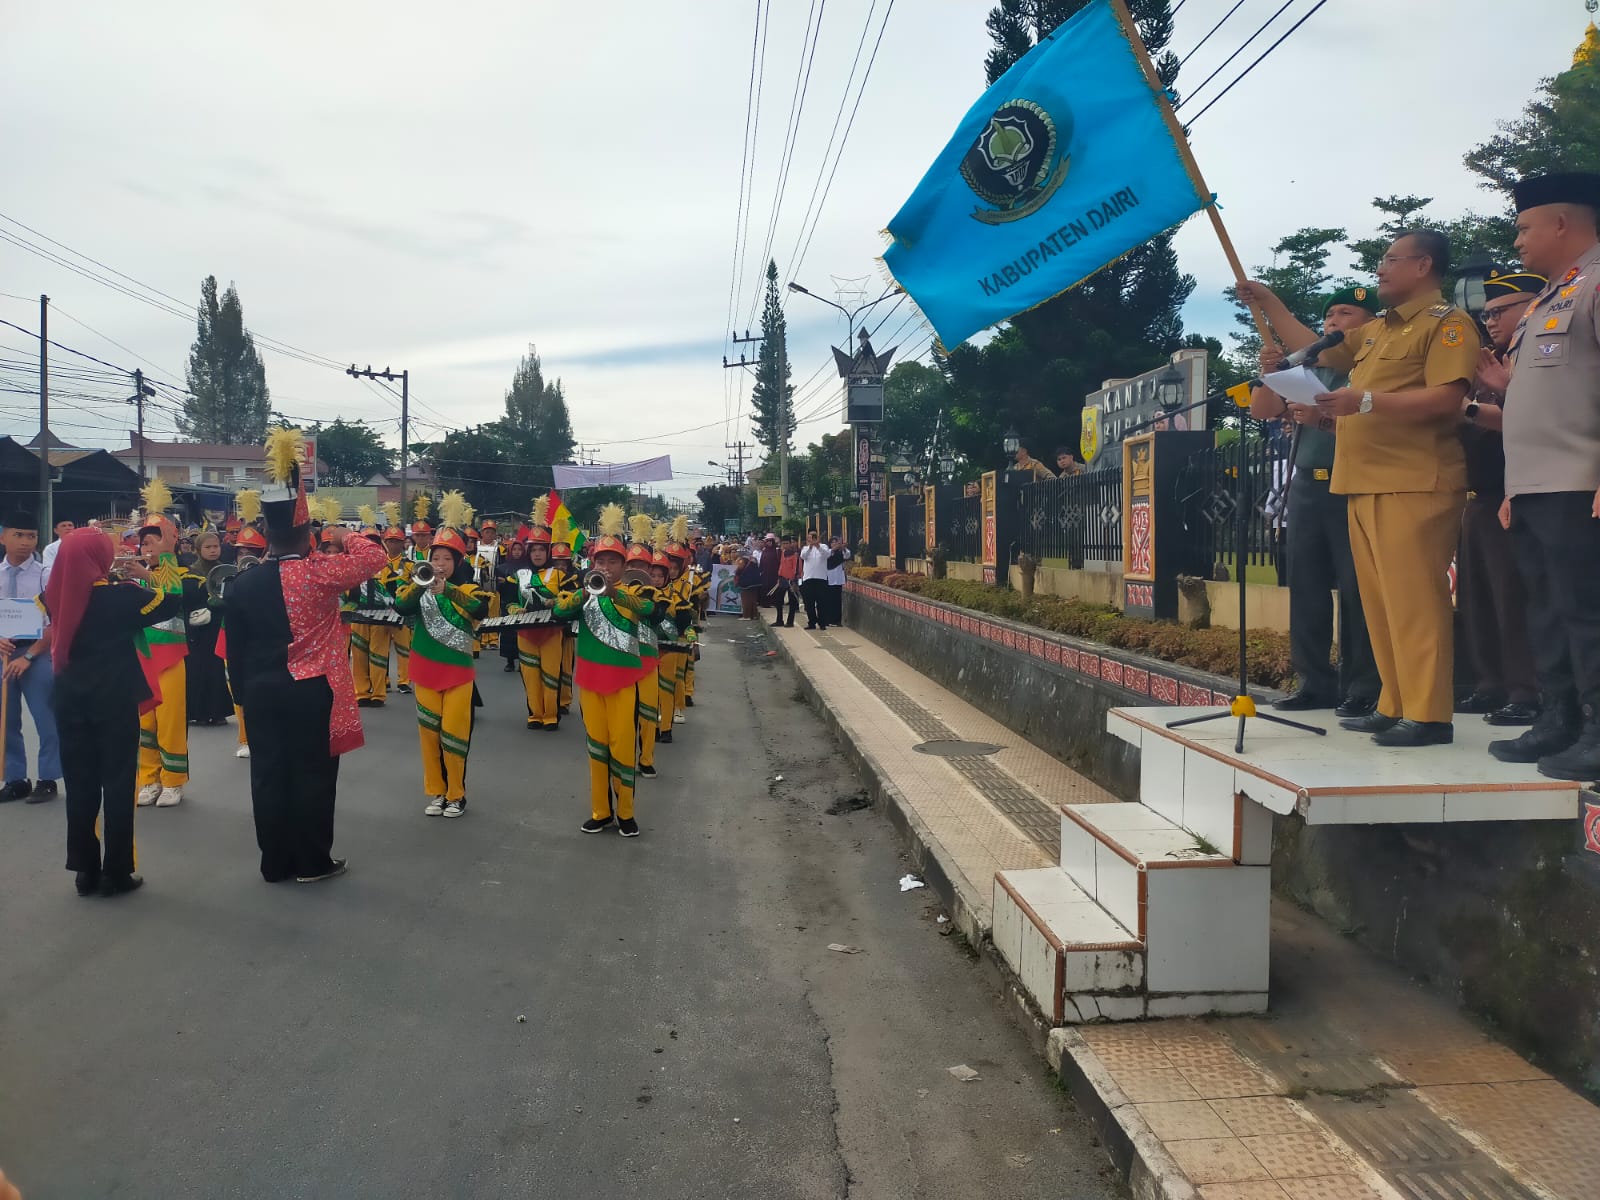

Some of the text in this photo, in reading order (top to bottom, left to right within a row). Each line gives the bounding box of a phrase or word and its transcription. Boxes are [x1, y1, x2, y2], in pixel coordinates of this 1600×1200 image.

[978, 218, 1089, 297] KABUPATEN
[1086, 186, 1140, 231] DAIRI
[1547, 299, 1574, 314] POLRI
[1103, 374, 1160, 415] KANTO
